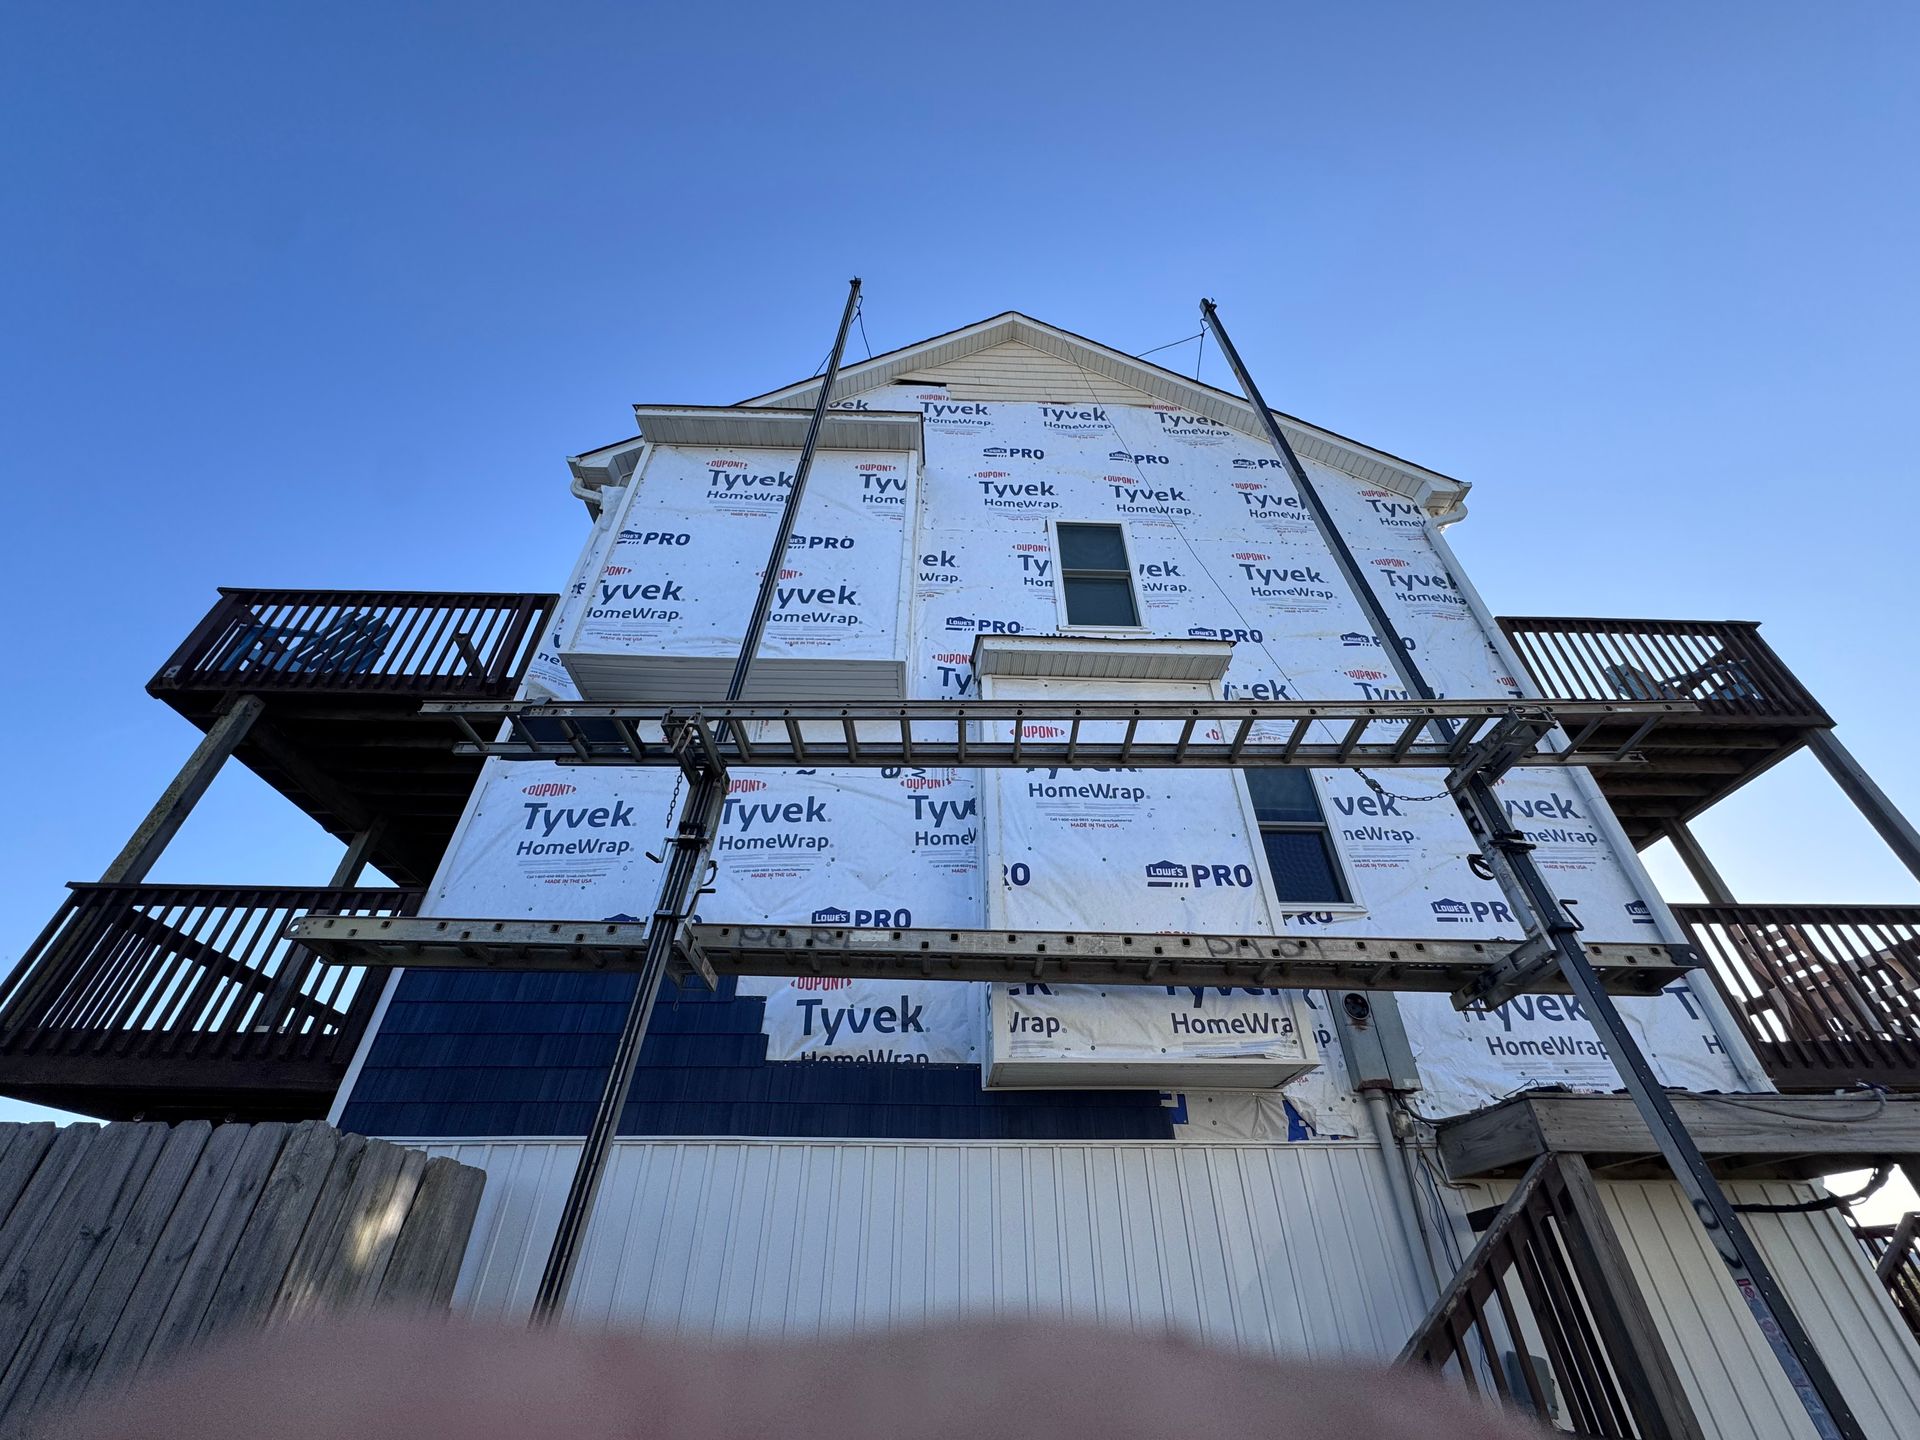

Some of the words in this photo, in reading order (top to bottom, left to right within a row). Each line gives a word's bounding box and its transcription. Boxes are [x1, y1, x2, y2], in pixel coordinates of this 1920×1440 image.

[920, 402, 989, 417] Tyvek
[1038, 407, 1106, 422] Tyvek
[924, 416, 991, 427] HomeWrap
[1043, 421, 1112, 430] HomeWrap
[1162, 427, 1231, 437] HomeWrap
[1010, 448, 1045, 460] PRO
[1134, 454, 1170, 465] PRO
[710, 460, 744, 469] DUPONT
[859, 464, 893, 472] DUPONT
[708, 469, 794, 491] Tyvek
[1107, 475, 1136, 484] DUPONT
[979, 481, 1054, 498] Tyvek
[1109, 484, 1186, 503] Tyvek
[1234, 483, 1263, 491] DUPONT
[984, 498, 1060, 510] HomeWrap
[1116, 504, 1192, 516] HomeWrap
[643, 533, 691, 546] PRO
[808, 536, 856, 549] PRO
[1235, 553, 1268, 562] DUPONT
[1374, 559, 1408, 568] DUPONT
[1239, 564, 1326, 587] Tyvek
[600, 580, 684, 605] yvek
[760, 585, 858, 609] yvek
[1251, 587, 1334, 600] HomeWrap
[948, 618, 974, 627] LOWE'S
[978, 619, 1021, 634] PRO
[1220, 629, 1263, 643] PRO
[1348, 669, 1382, 681] DUPONT
[528, 783, 572, 797] DUPONT
[1028, 782, 1145, 803] HomeWrap
[523, 800, 635, 838] Tyvek
[722, 796, 827, 832] Tyvek
[516, 837, 631, 856] HomeWrap
[719, 833, 830, 852] HomeWrap
[1149, 866, 1185, 878] LOWE'S
[1192, 864, 1254, 888] PRO
[1434, 904, 1468, 914] LOWE'S
[815, 912, 848, 923] LOWE'S
[854, 908, 912, 928] PRO
[796, 995, 924, 1046] Tyvek
